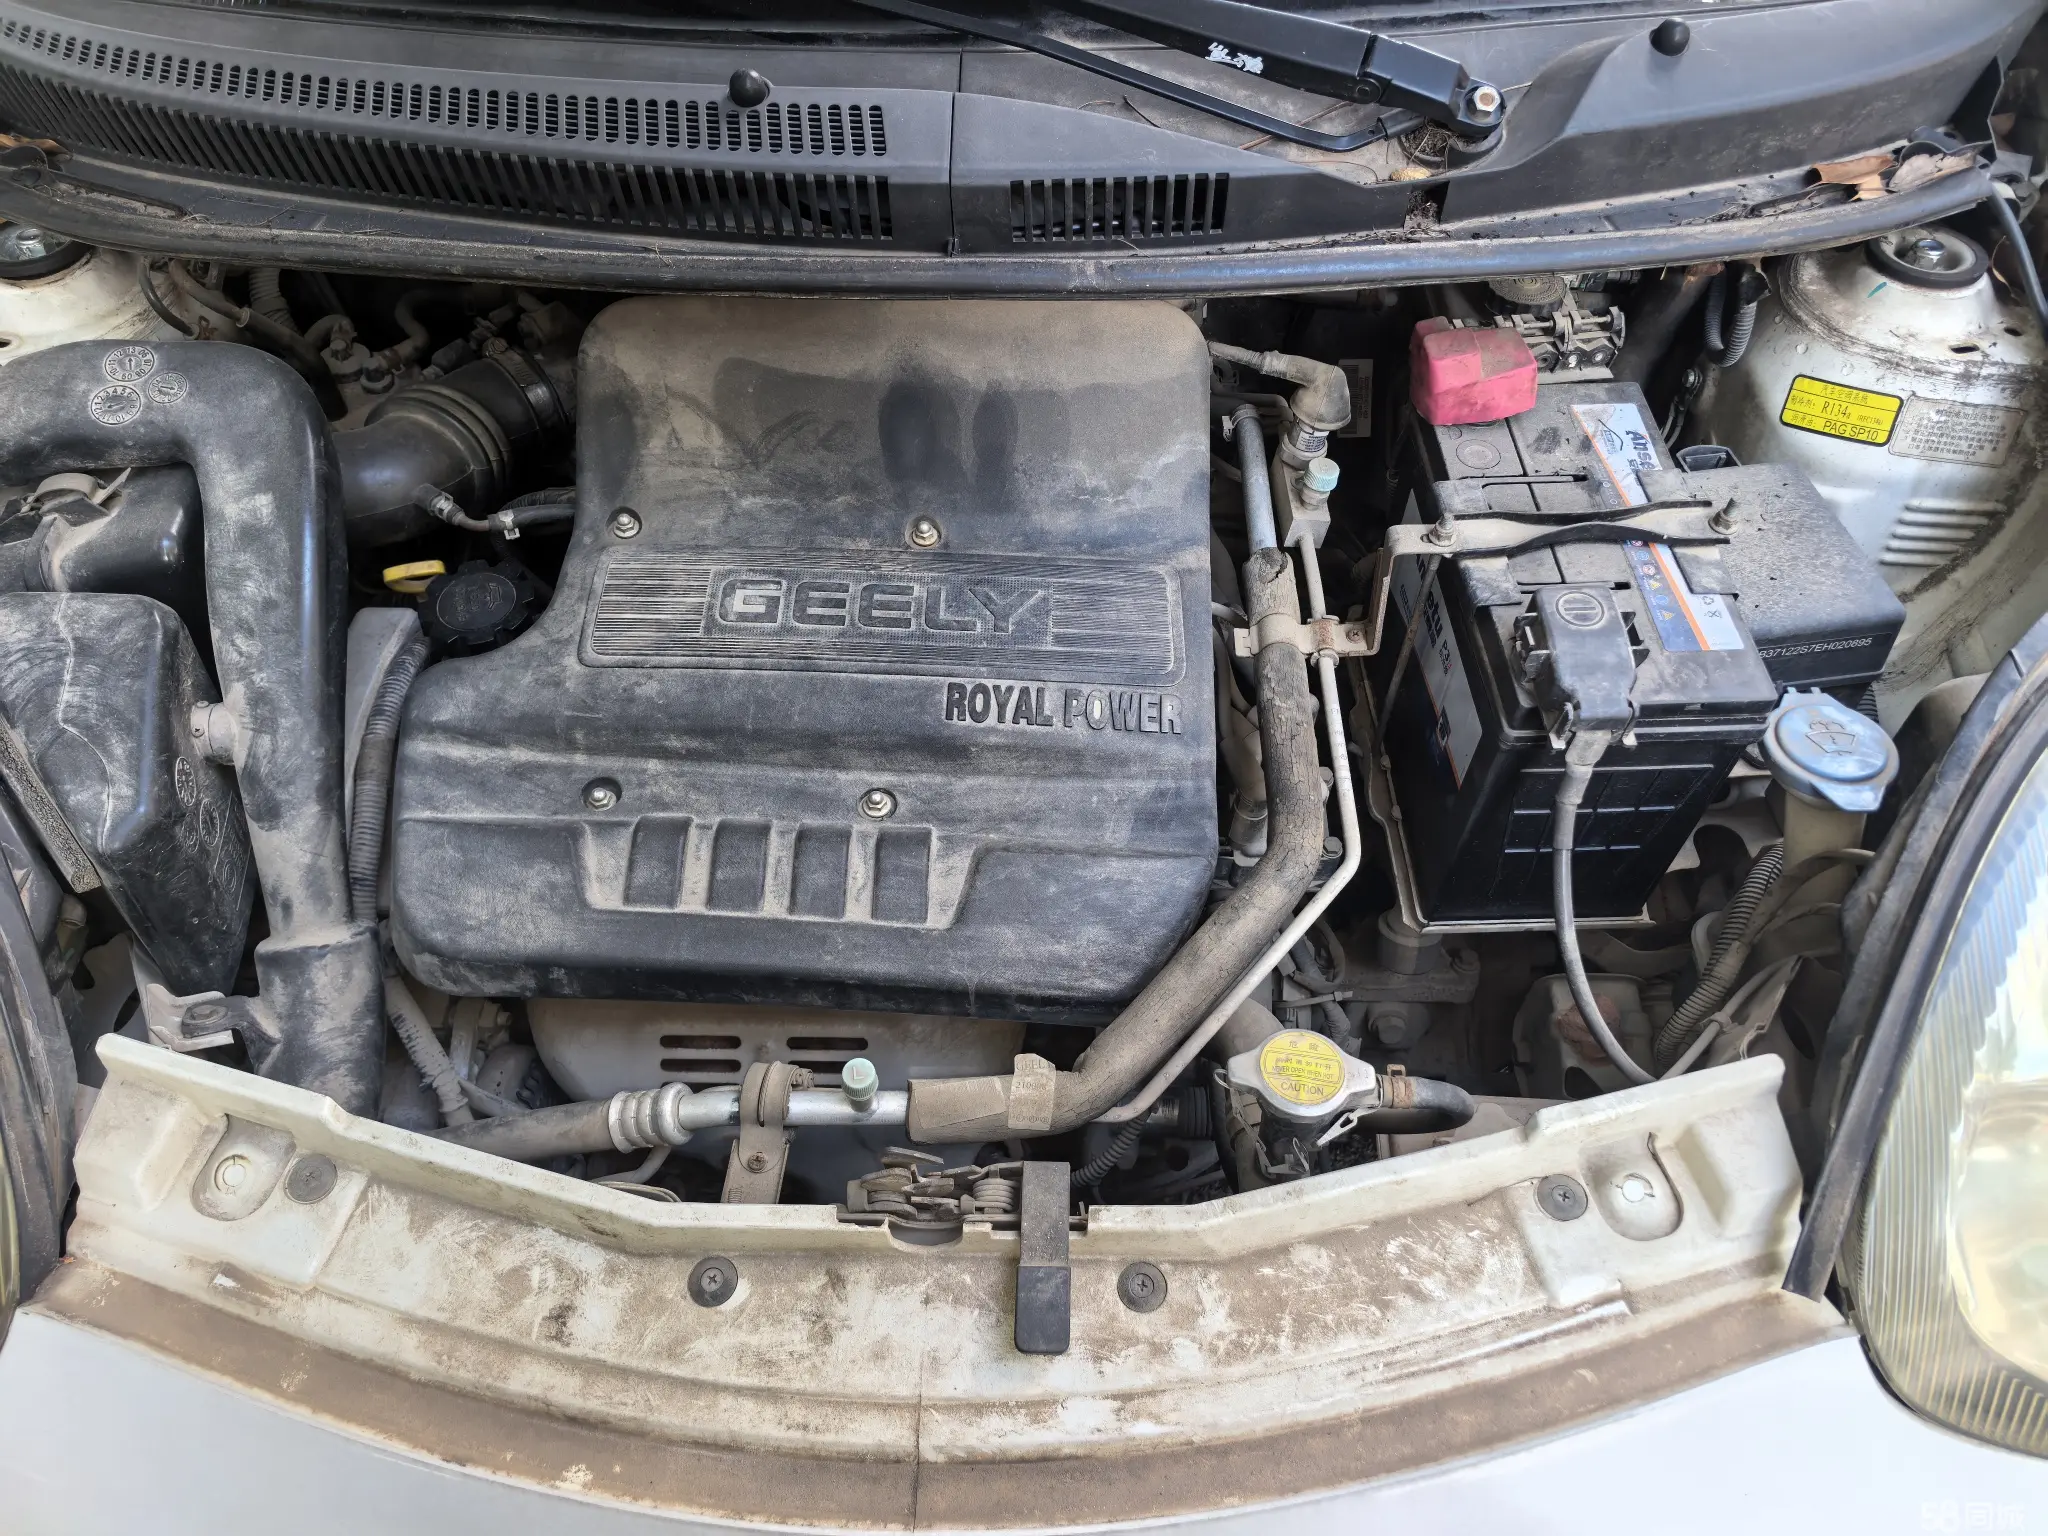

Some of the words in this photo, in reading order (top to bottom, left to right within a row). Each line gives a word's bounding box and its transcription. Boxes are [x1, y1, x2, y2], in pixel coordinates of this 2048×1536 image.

[1822, 420, 1847, 435] PAG
[1849, 426, 1879, 442] SP10
[719, 578, 1043, 635] GEELY
[945, 682, 1054, 727] ROYAL
[1063, 688, 1183, 736] POWER
[1281, 1081, 1324, 1097] CAUTION
